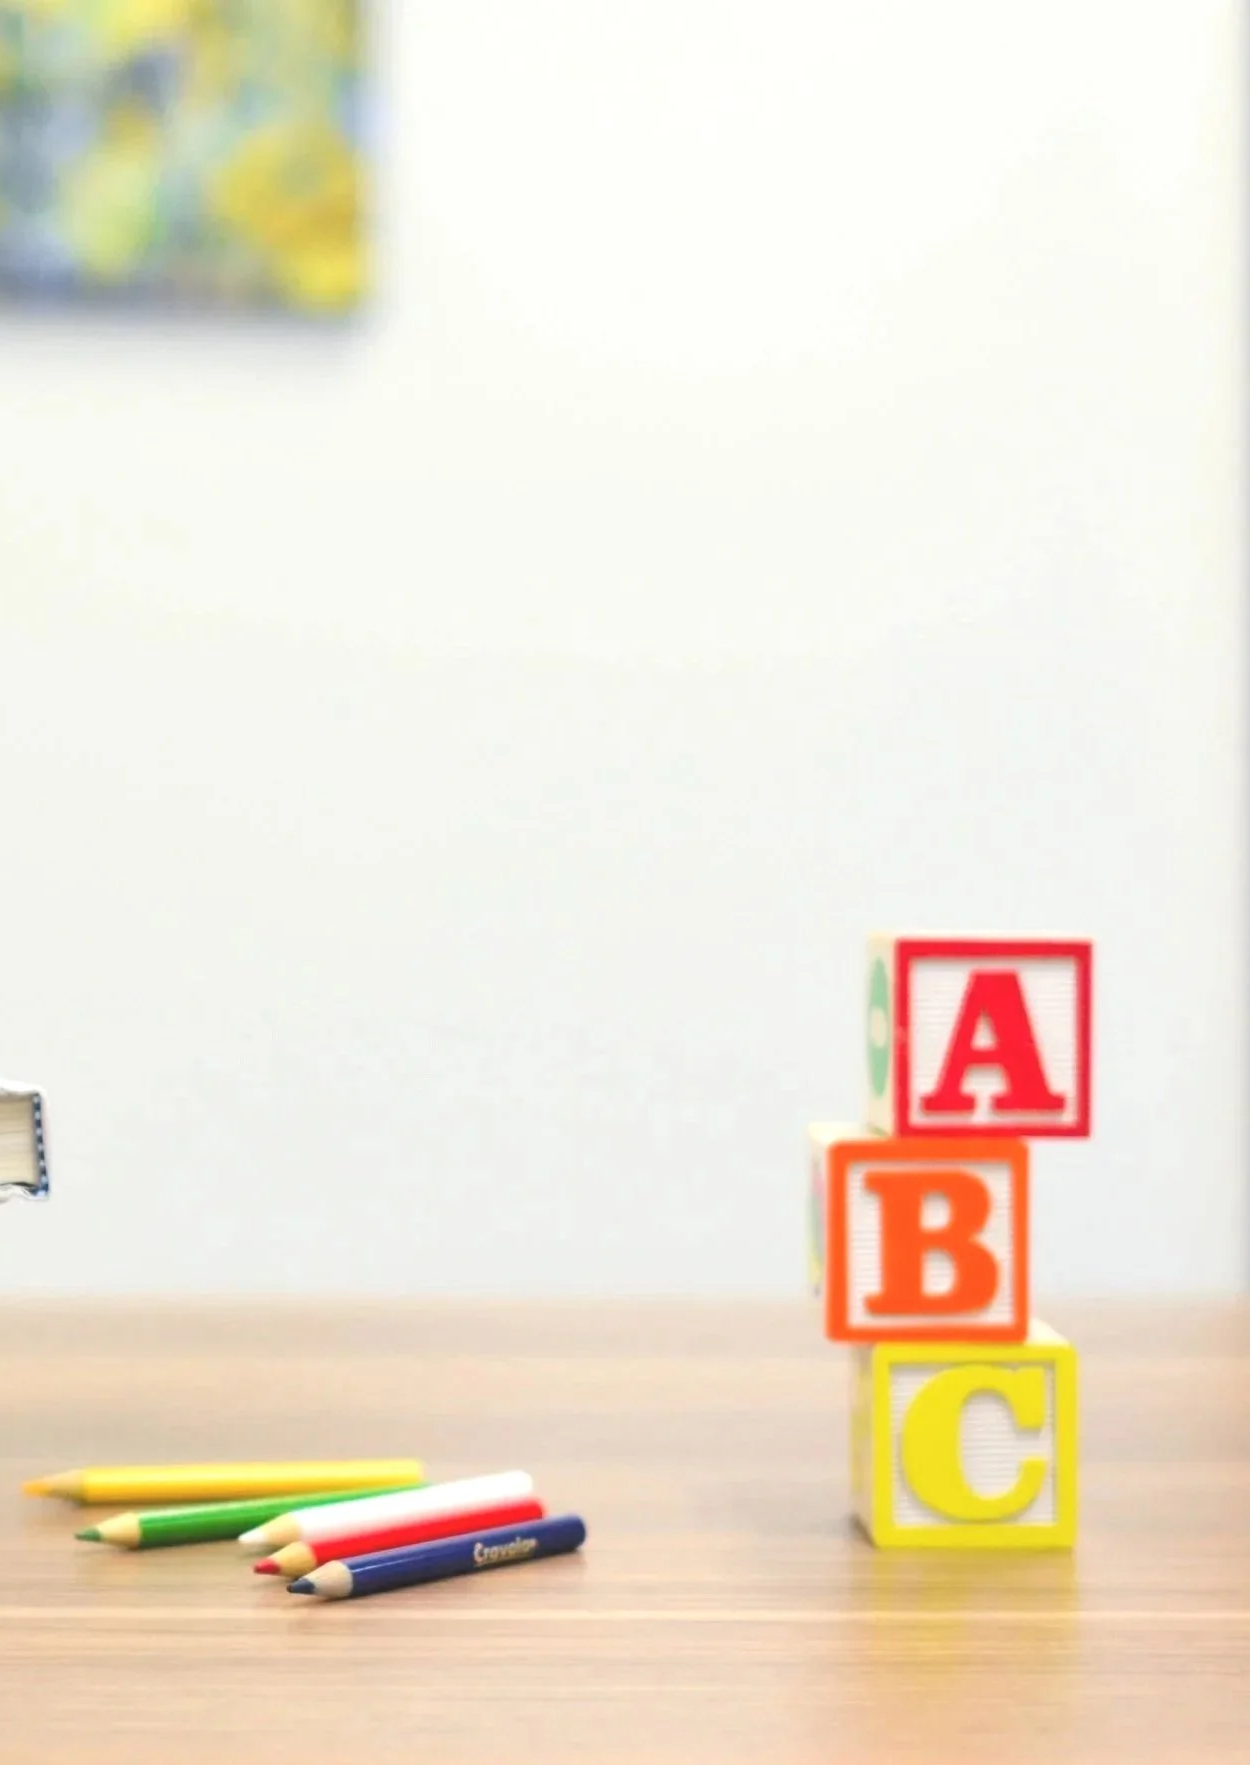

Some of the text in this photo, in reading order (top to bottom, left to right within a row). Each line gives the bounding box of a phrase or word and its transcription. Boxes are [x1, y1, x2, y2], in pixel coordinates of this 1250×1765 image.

[919, 968, 1066, 1112] A
[863, 1168, 1000, 1315] B
[901, 1364, 1047, 1522] C
